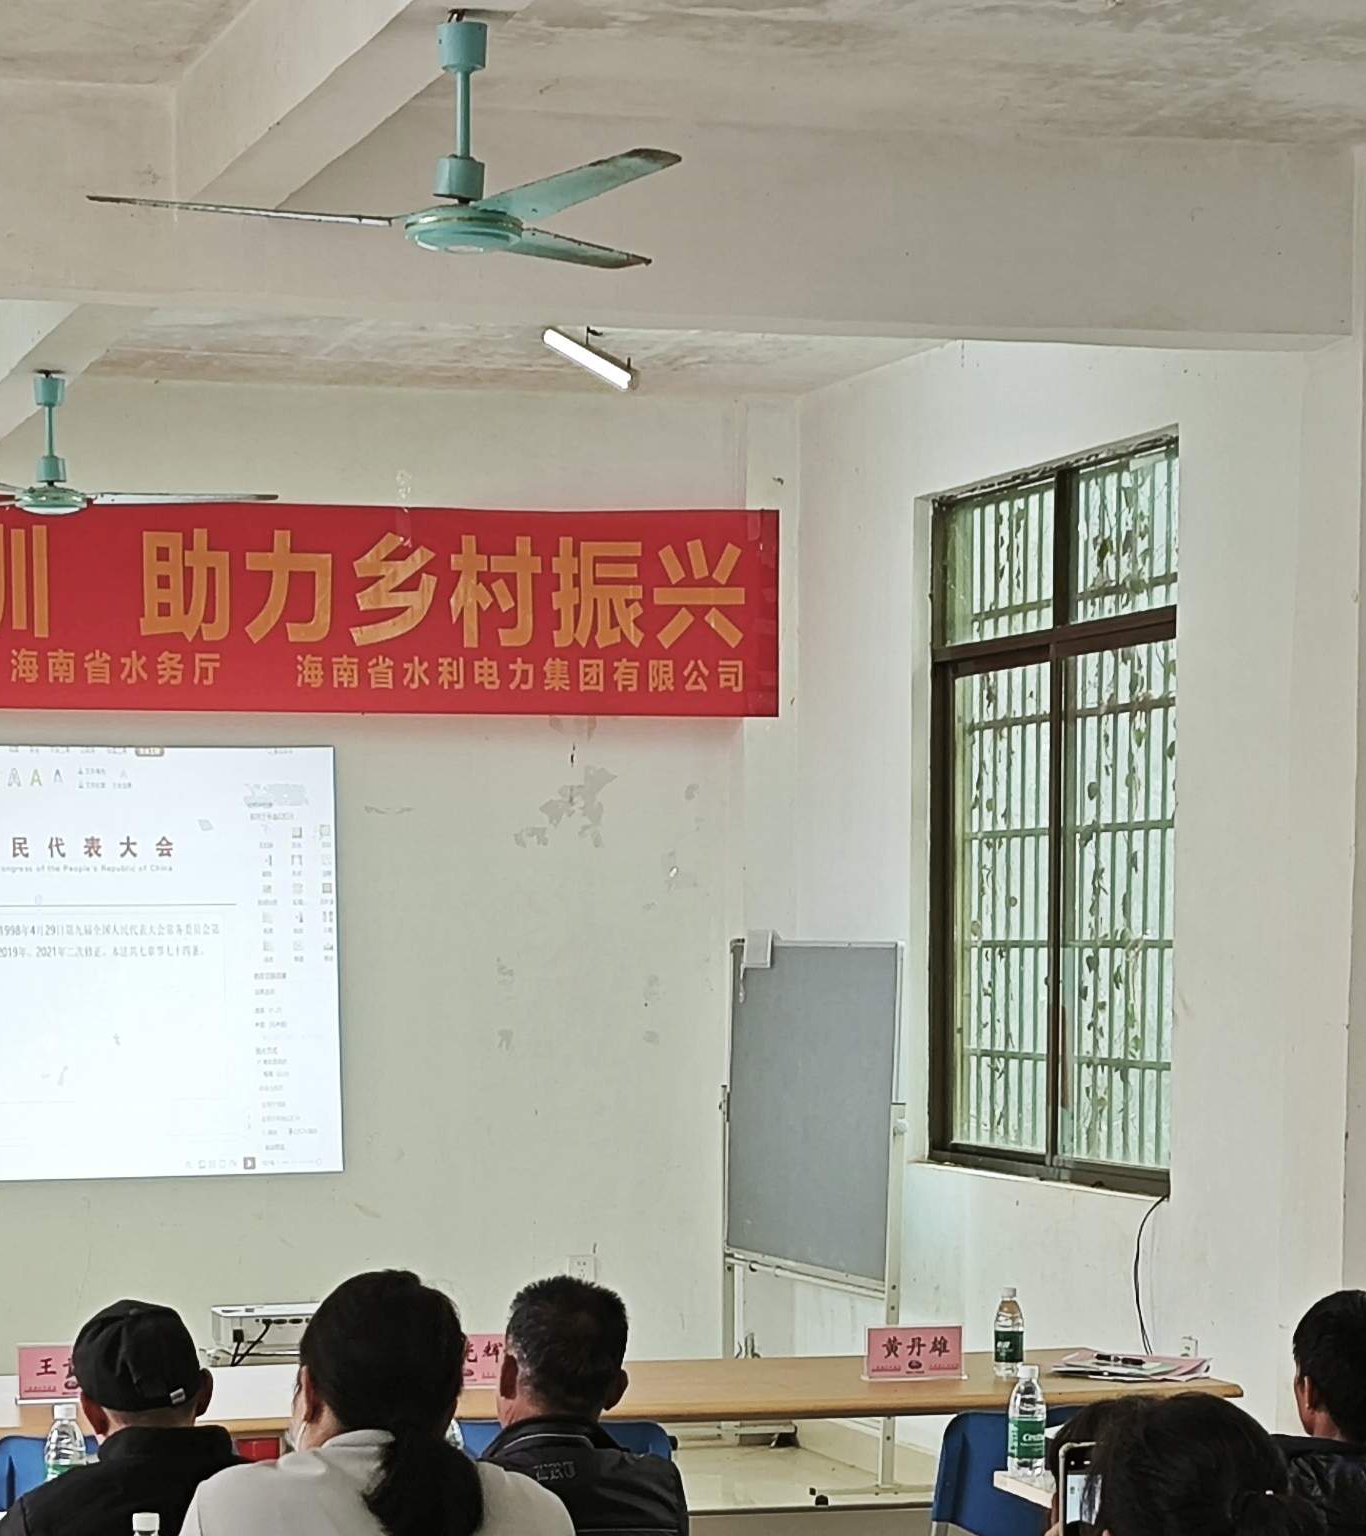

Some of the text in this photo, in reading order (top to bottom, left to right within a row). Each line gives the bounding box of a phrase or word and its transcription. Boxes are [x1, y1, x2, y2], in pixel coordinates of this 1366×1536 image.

[139, 528, 747, 650] 助力乡村振兴
[10, 647, 746, 694] 海南省水务厅 海南省水利电力集团有限公司
[881, 1335, 951, 1359] 黄丹雄
